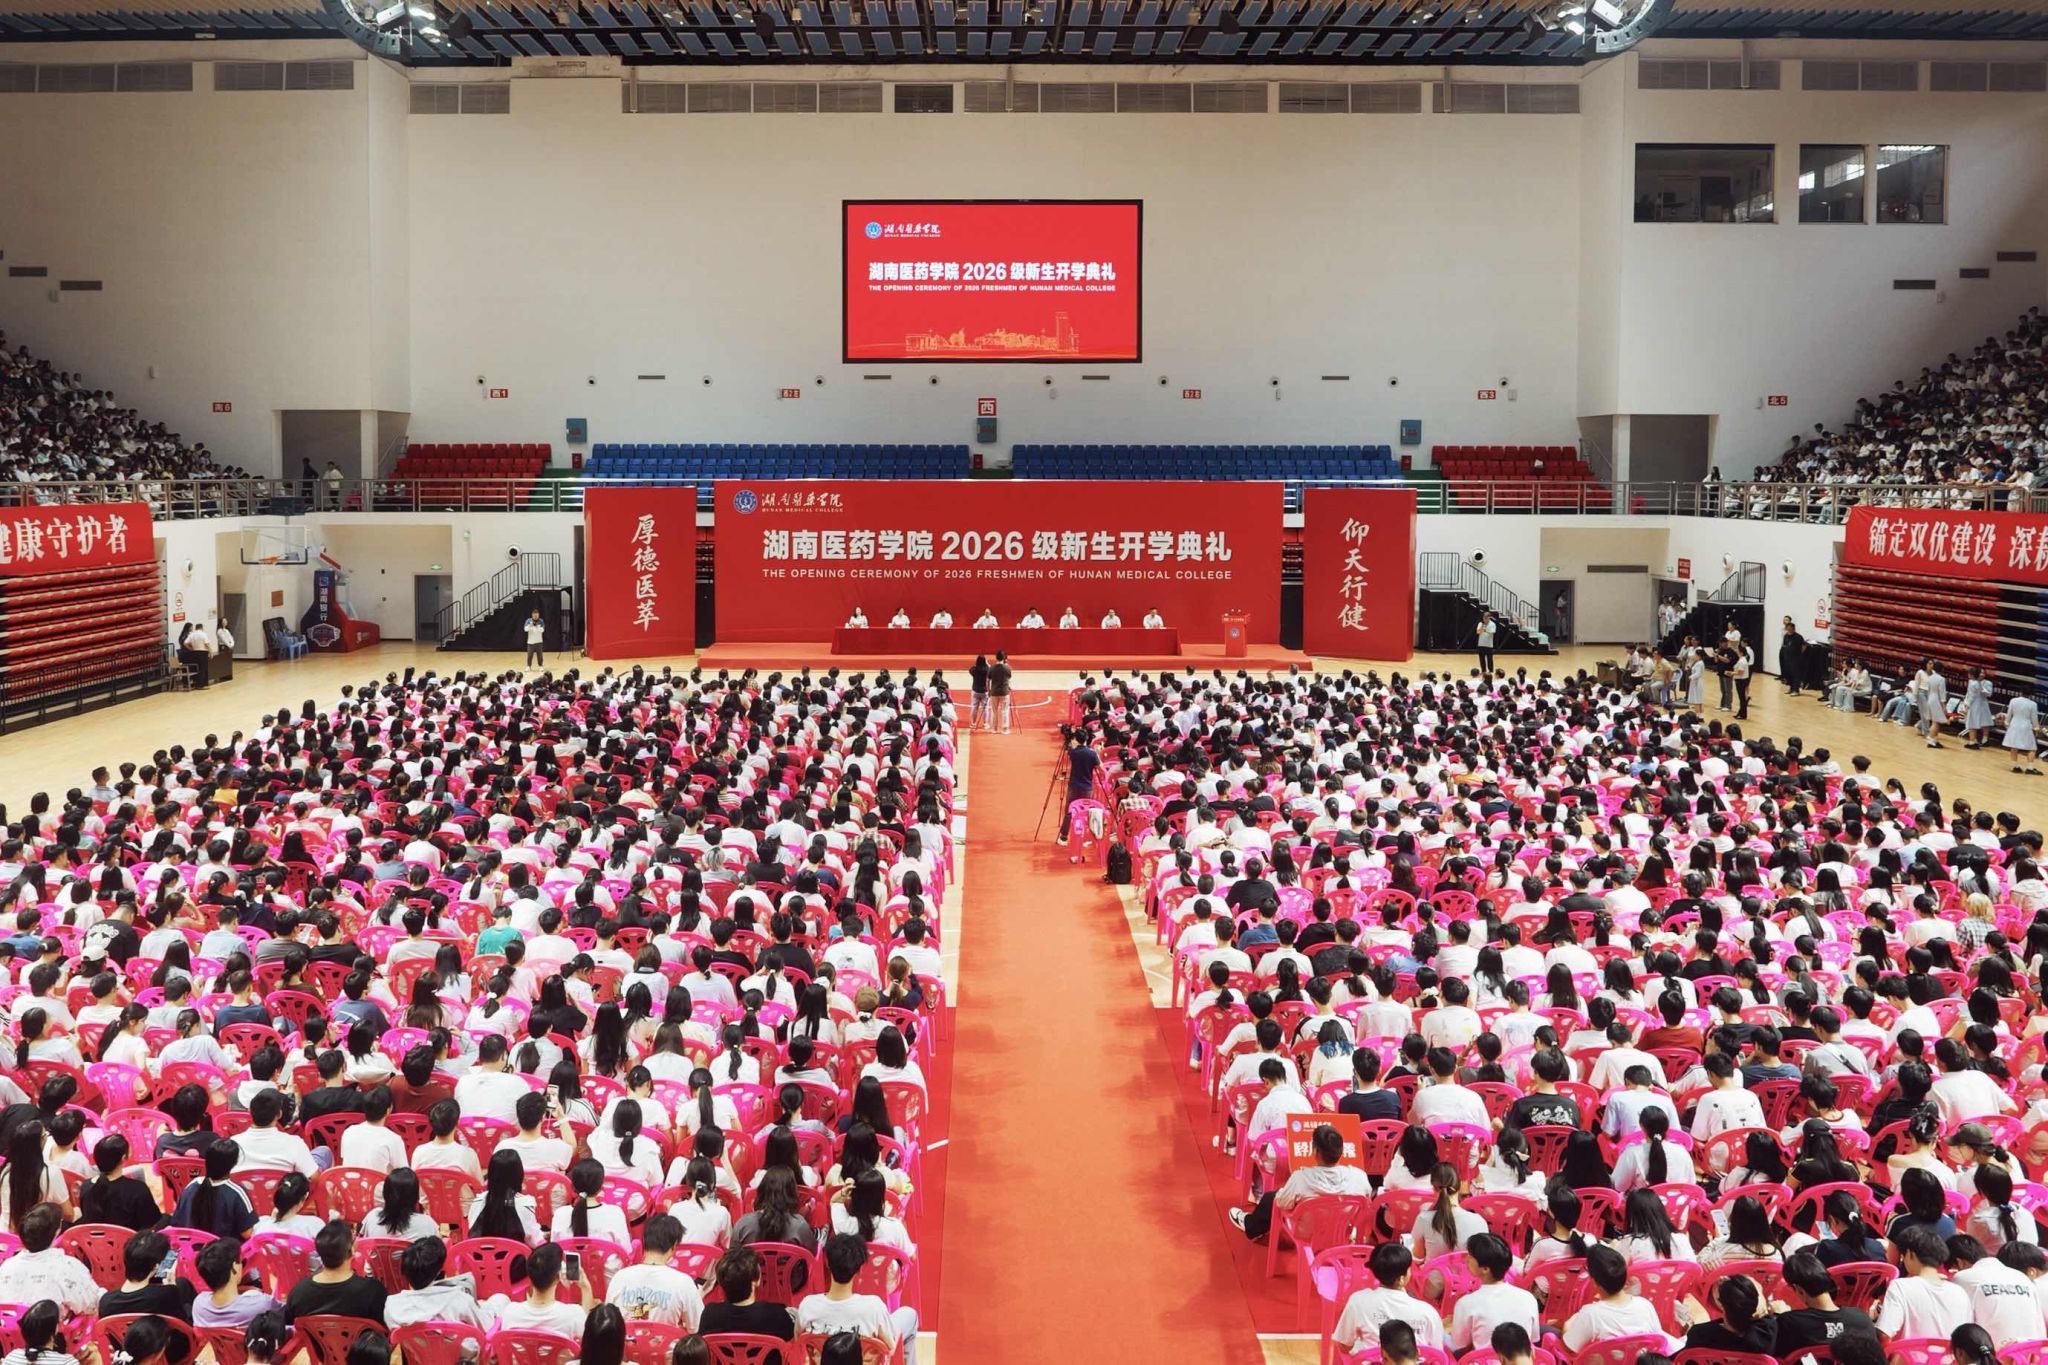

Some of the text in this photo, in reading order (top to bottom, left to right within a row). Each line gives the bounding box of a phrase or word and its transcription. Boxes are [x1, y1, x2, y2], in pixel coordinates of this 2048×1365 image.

[869, 262, 1116, 281] 湖南医药学院 2026 级新生开学典礼
[980, 400, 995, 414] 西
[763, 529, 1232, 562] 湖南医药学院 2026 级新生开学典礼
[1869, 516, 1996, 566] 锚定双优建设
[631, 513, 660, 632] 厚德医萃
[763, 569, 1232, 580] THE OPENING CEREMONY OF 2026 FRESHMEN OF HUNAN MEDICAL COLLEGE
[1338, 517, 1370, 631] 仰天行健
